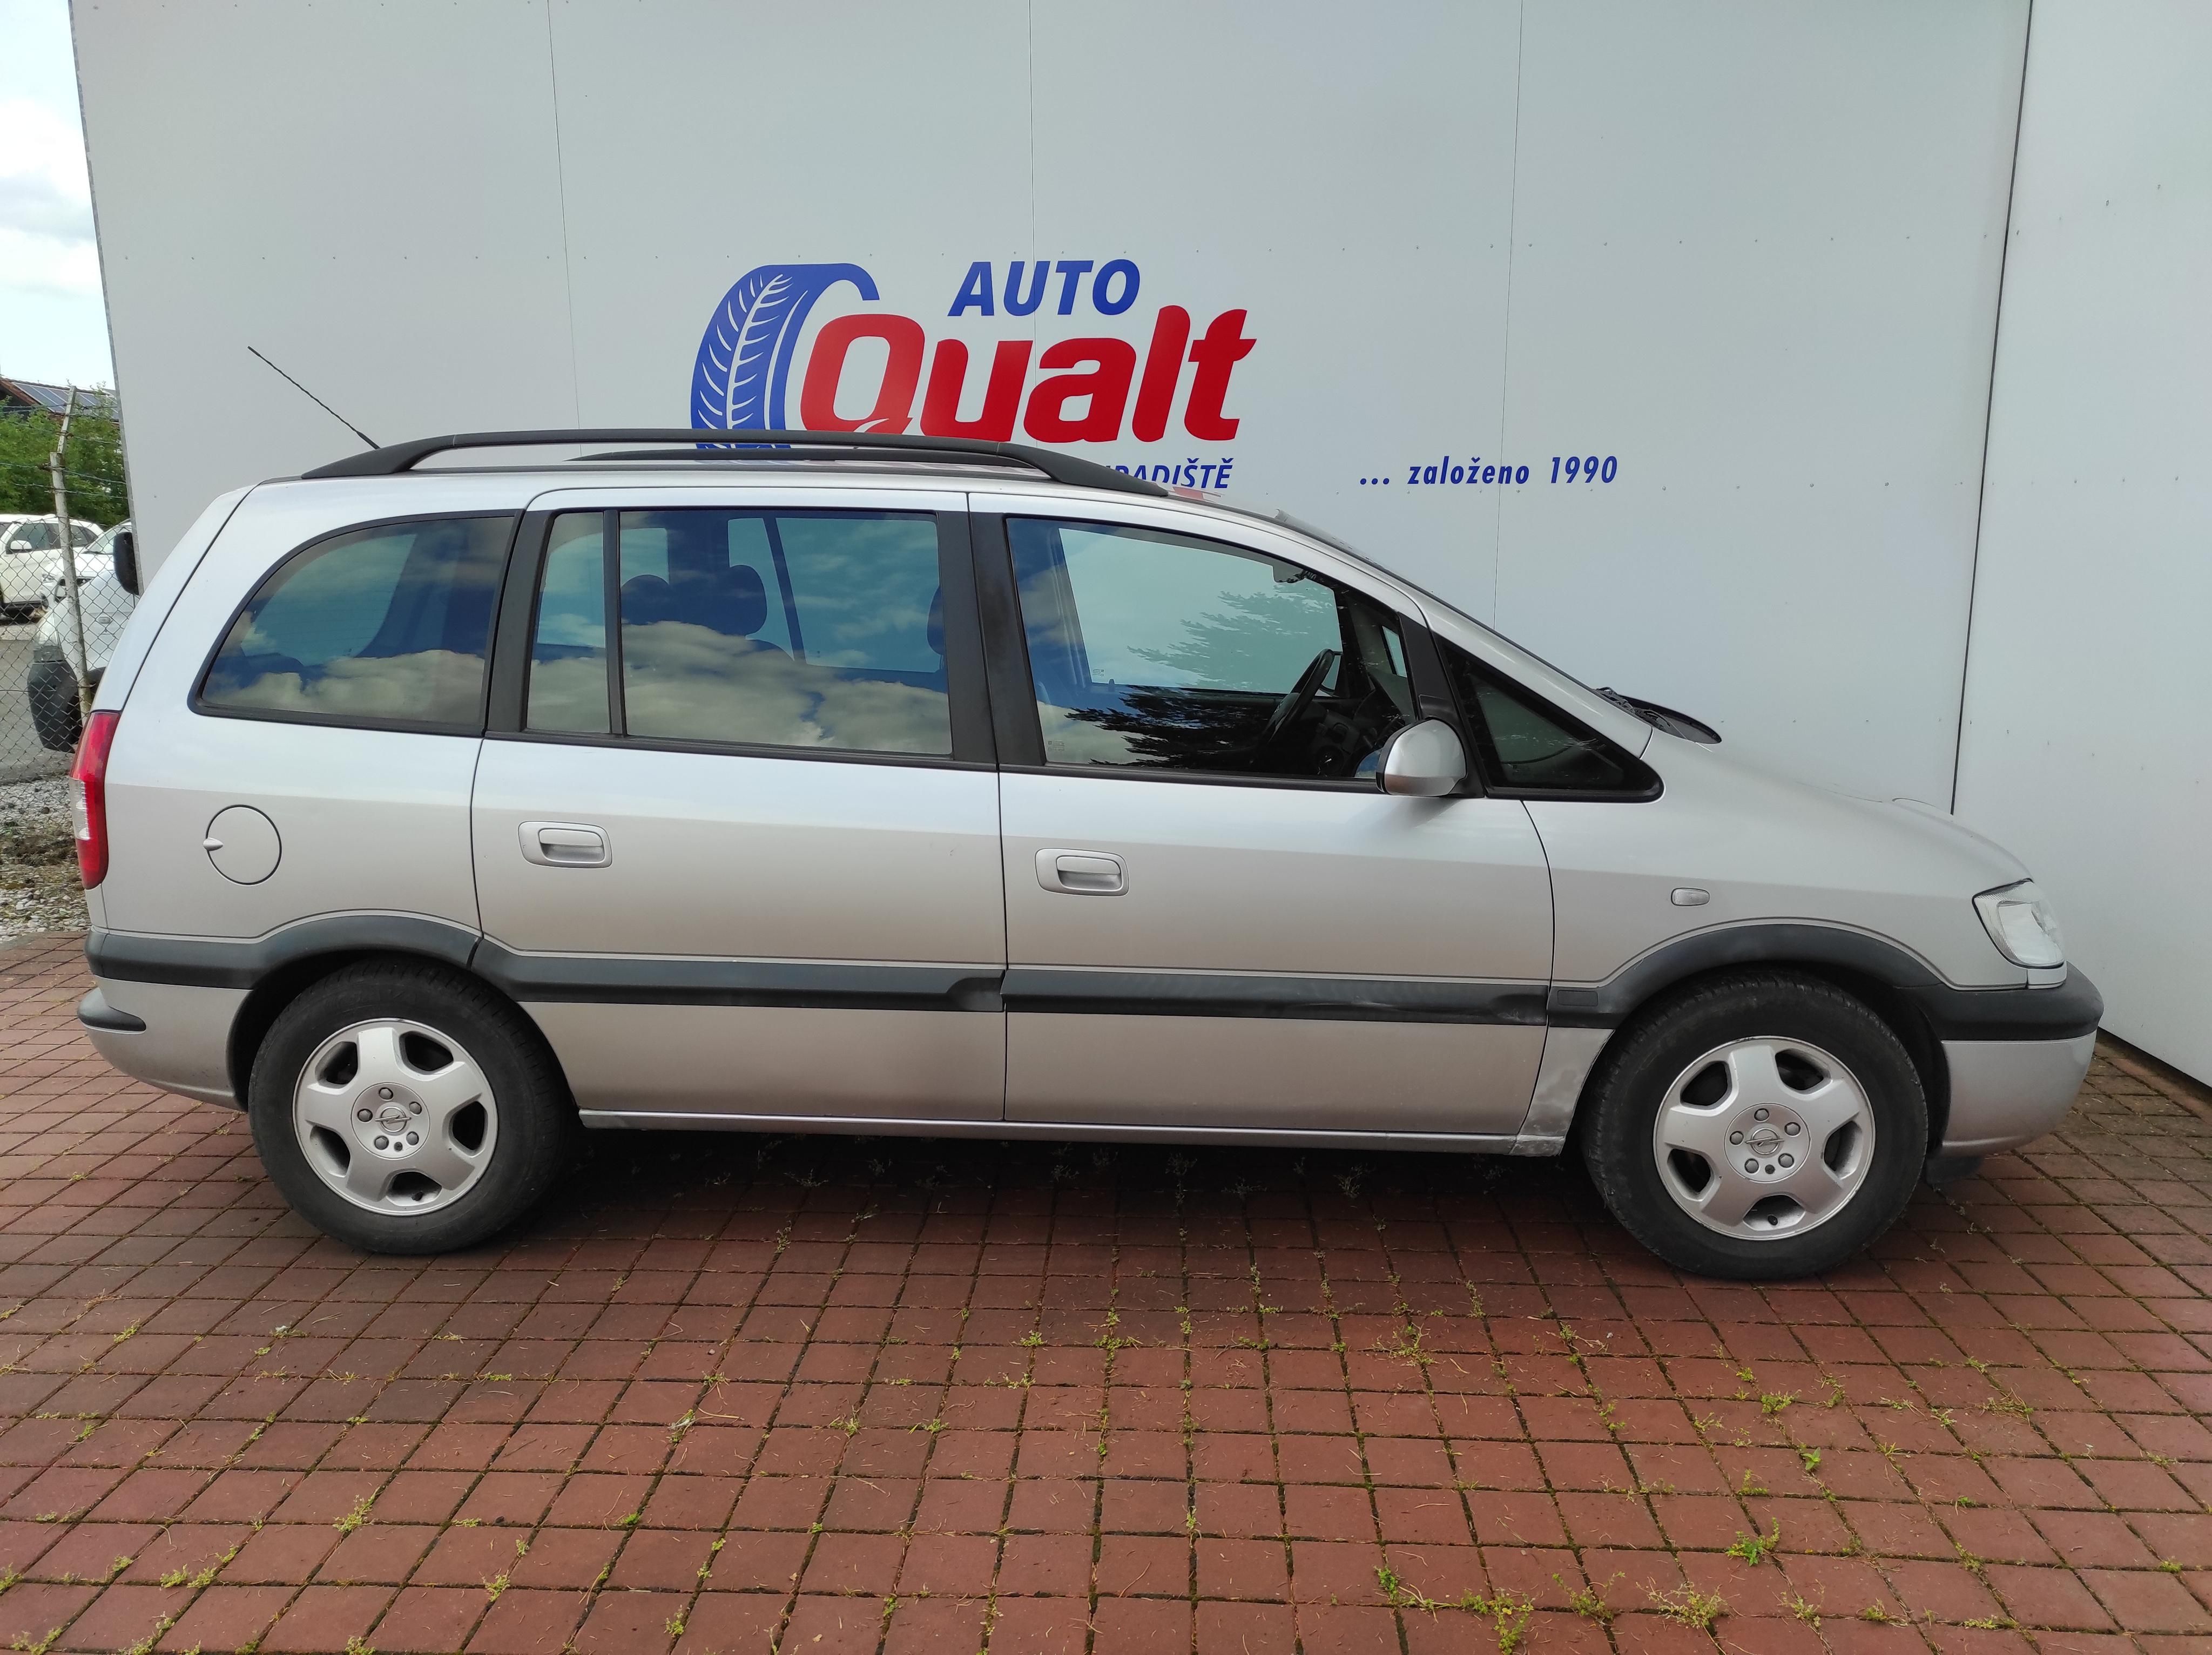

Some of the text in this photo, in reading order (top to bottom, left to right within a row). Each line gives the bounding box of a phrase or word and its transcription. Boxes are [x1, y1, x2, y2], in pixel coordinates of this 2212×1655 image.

[948, 259, 1141, 317] AUTO
[800, 305, 1257, 443] Qualt
[1105, 457, 1235, 489] ADIŠTĚ
[1407, 456, 1530, 485] založeno
[1550, 455, 1618, 484] 1990
